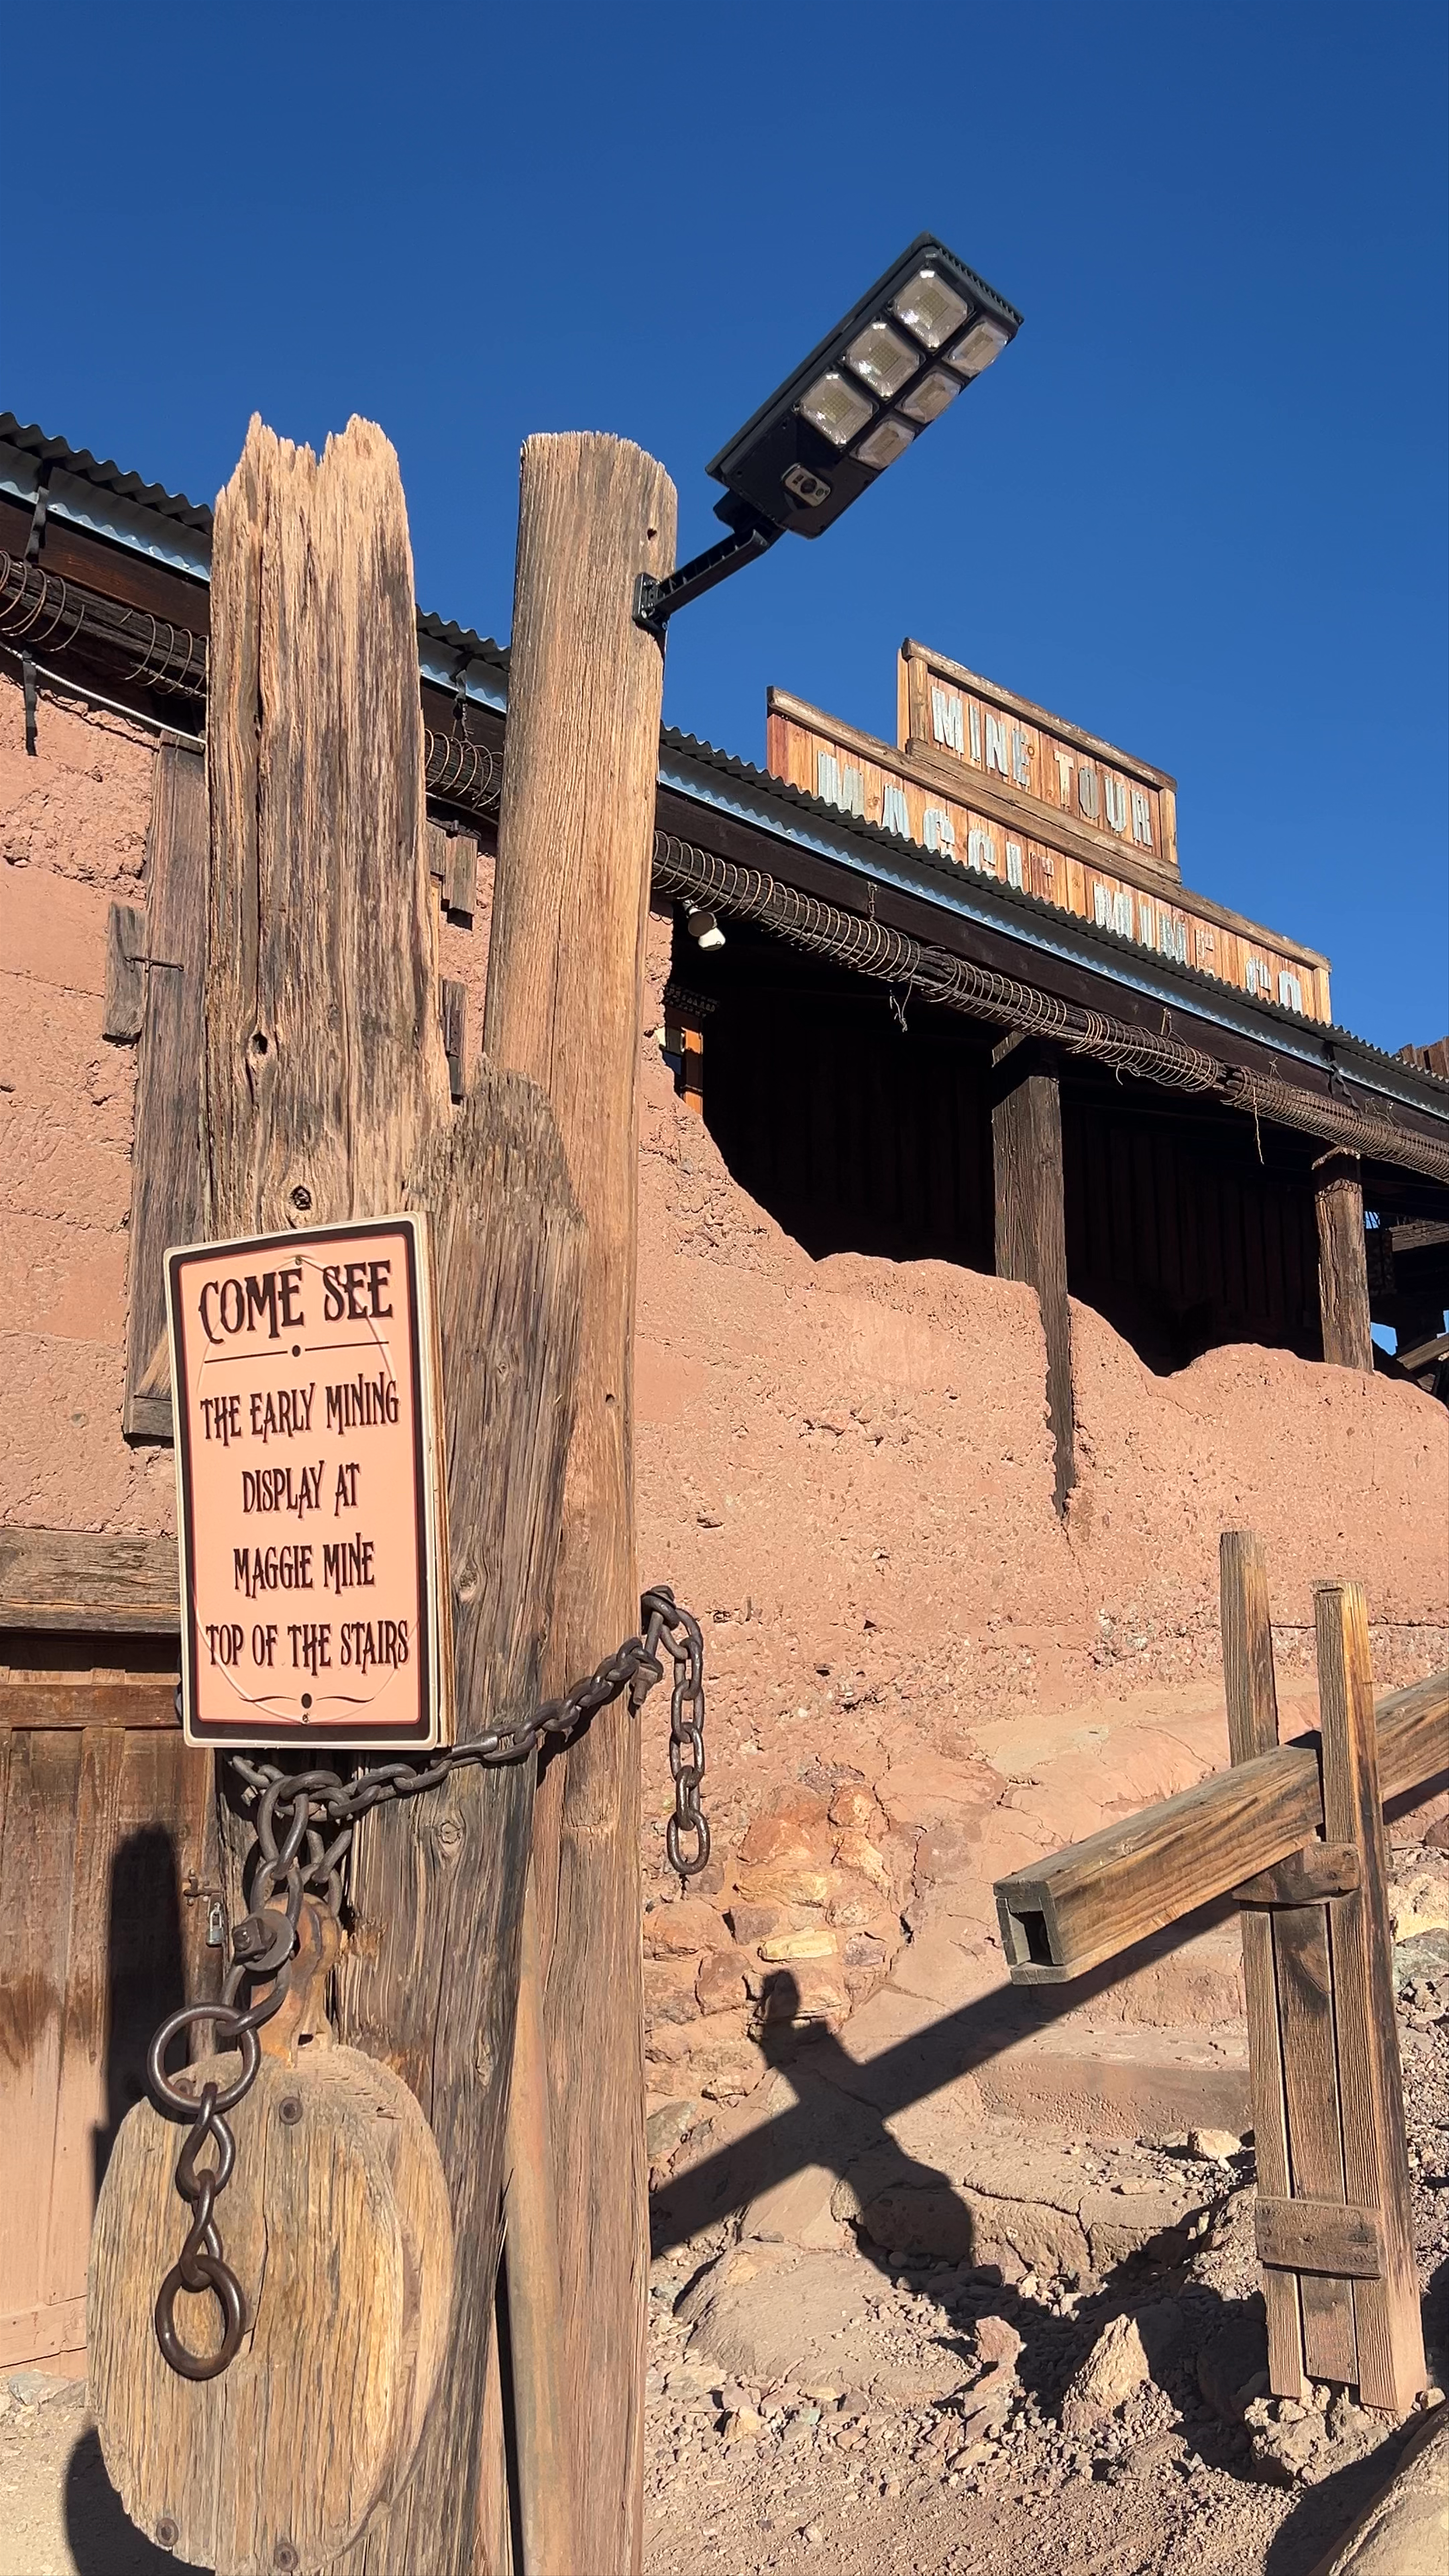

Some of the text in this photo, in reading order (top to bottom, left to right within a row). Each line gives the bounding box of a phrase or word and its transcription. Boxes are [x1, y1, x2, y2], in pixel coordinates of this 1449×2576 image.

[931, 686, 1153, 847] MINE TOUR
[1093, 881, 1214, 978] MINE
[198, 1260, 392, 1344] COME SEE
[200, 1372, 398, 1446] THE EARLY MINING
[242, 1460, 360, 1518] DISPLAY AT
[234, 1533, 374, 1598] MAGGIE MINE
[206, 1620, 408, 1676] TOP OF THE STAIRS
